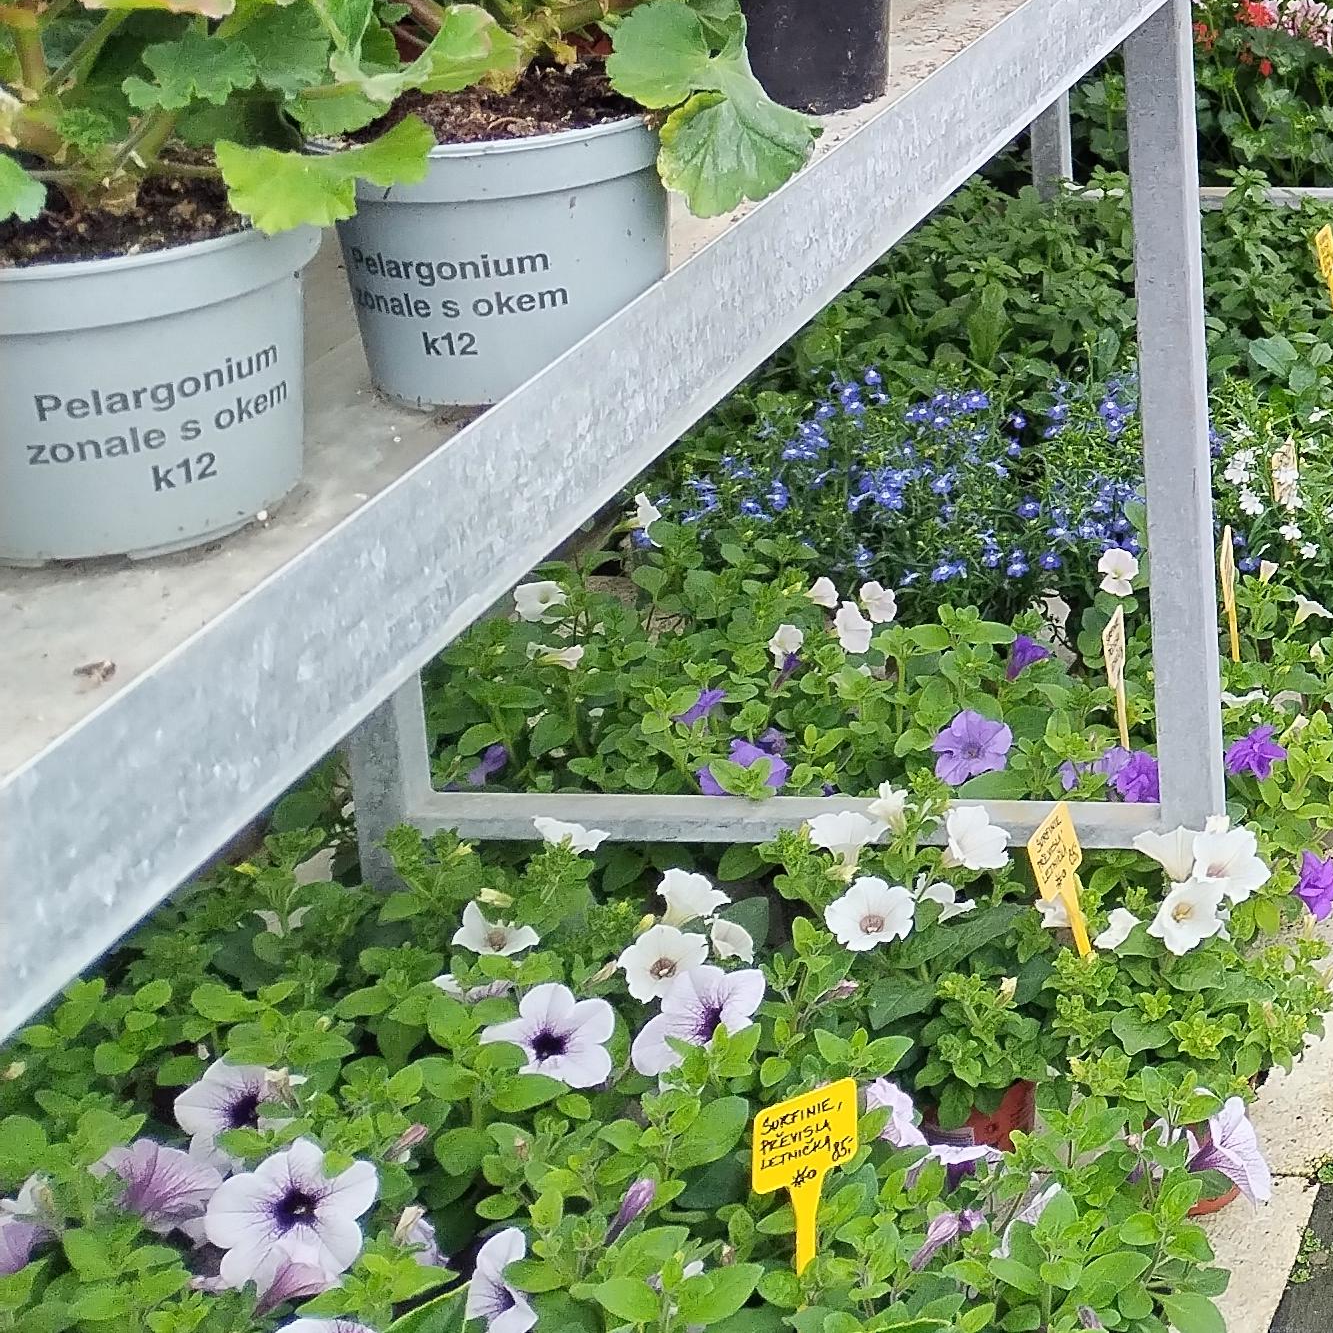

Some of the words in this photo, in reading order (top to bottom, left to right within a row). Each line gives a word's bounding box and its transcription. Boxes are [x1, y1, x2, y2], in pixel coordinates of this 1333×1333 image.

[351, 246, 549, 287] Pelargonium
[356, 287, 431, 317] zonale
[442, 299, 460, 318] s
[472, 287, 568, 317] okem
[422, 331, 478, 356] k12
[34, 344, 279, 422] Pelargonium
[26, 427, 166, 466] zonale
[180, 419, 202, 441] s
[214, 380, 288, 430] okem
[152, 452, 218, 492] k12
[760, 1136, 831, 1170] LETNIČKA
